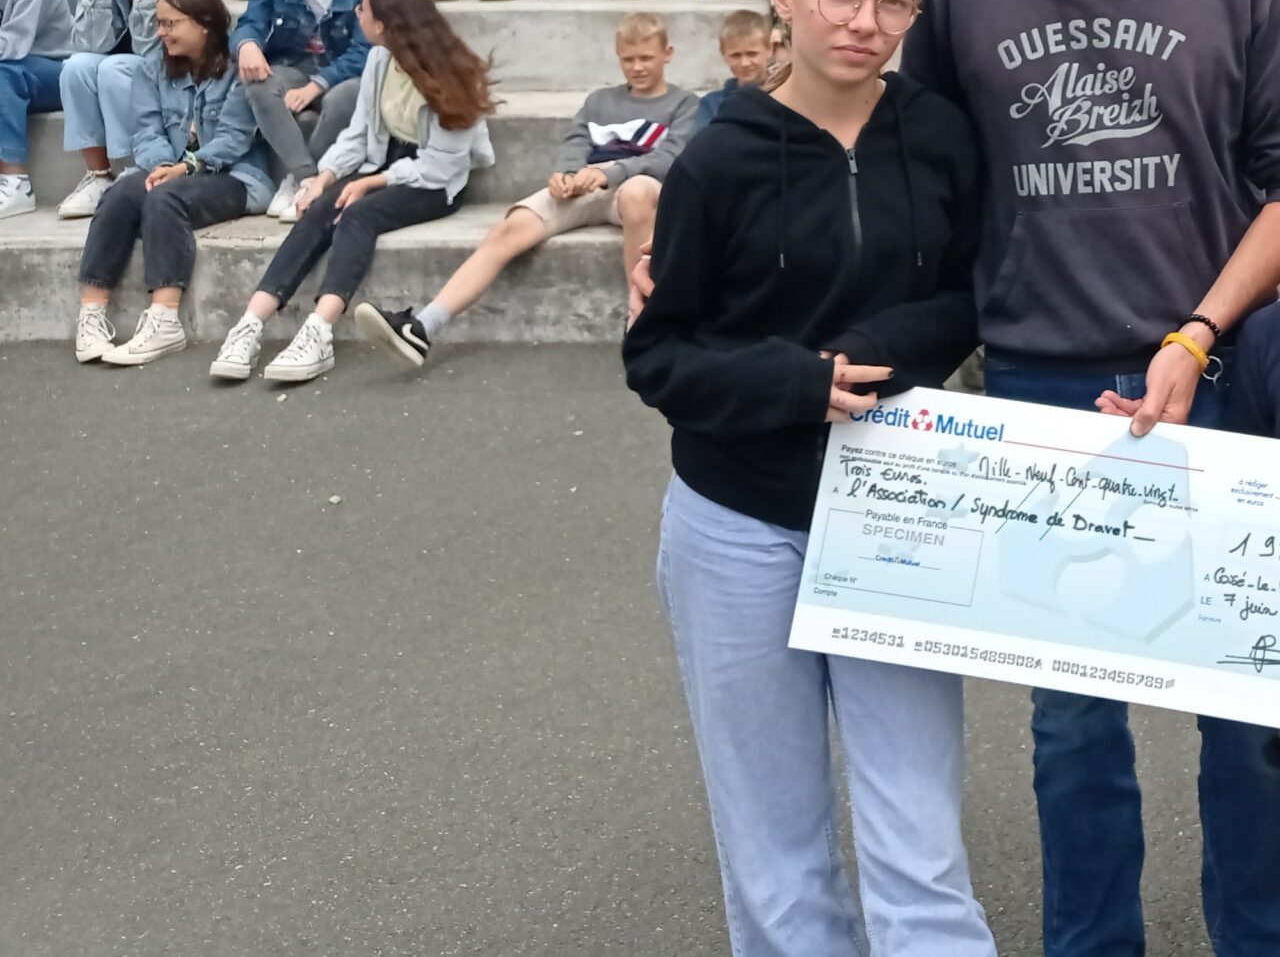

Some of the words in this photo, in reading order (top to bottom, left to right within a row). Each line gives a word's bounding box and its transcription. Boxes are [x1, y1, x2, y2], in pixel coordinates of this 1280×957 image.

[997, 17, 1186, 70] OUESSANT
[1009, 62, 1136, 119] Alaise
[1041, 83, 1160, 148] Breizh
[1013, 153, 1181, 197] UNIVERSITY
[850, 405, 911, 428] Crédit
[935, 414, 1005, 442] Mutuel
[841, 444, 863, 456] Payez
[840, 459, 872, 477] Trois
[865, 509, 900, 523] Payable
[903, 517, 915, 525] en
[918, 517, 948, 530] France
[970, 497, 1038, 524] Syndrome
[1046, 509, 1065, 527] de
[1073, 514, 1135, 538] Dravet
[862, 524, 946, 546] SPECIMEN
[1229, 532, 1251, 557] 1
[1200, 596, 1212, 605] LE
[1223, 593, 1236, 606] 7
[1240, 596, 1278, 621] juin
